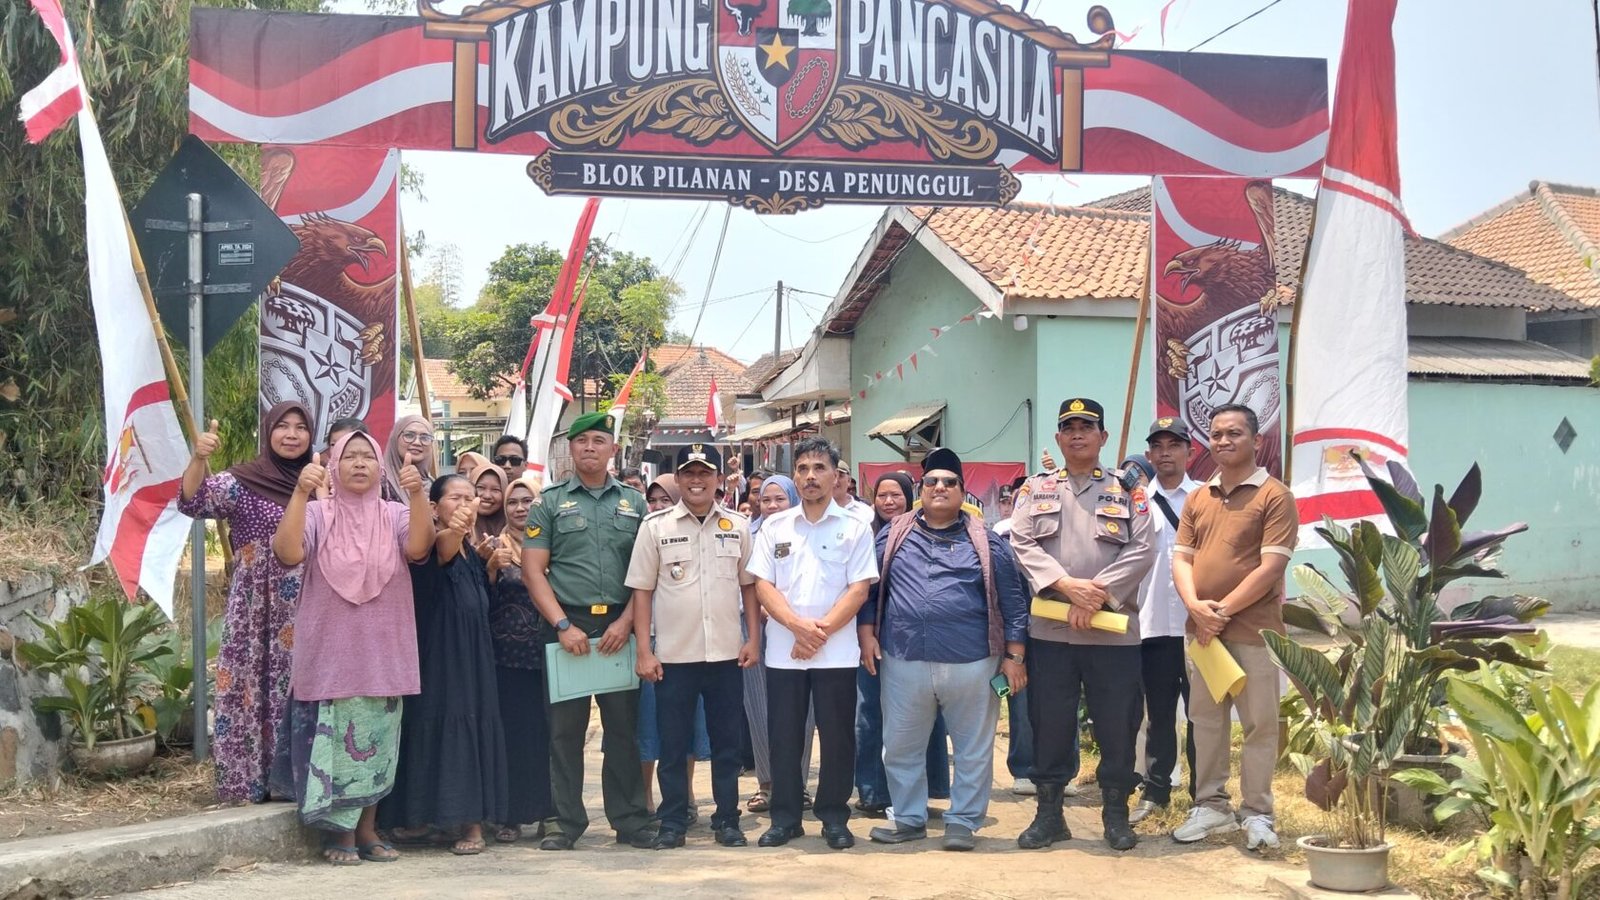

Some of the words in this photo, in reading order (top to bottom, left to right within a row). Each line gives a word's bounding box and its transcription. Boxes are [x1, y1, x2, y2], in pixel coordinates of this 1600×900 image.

[491, 0, 709, 133] KAMPUNG
[848, 0, 1058, 154] PANCASILA
[582, 163, 645, 187] BLOK
[653, 166, 752, 190] PILANAN
[779, 170, 836, 193] DESA
[843, 173, 974, 196] PENUNGGUL
[1098, 495, 1127, 506] POLRI
